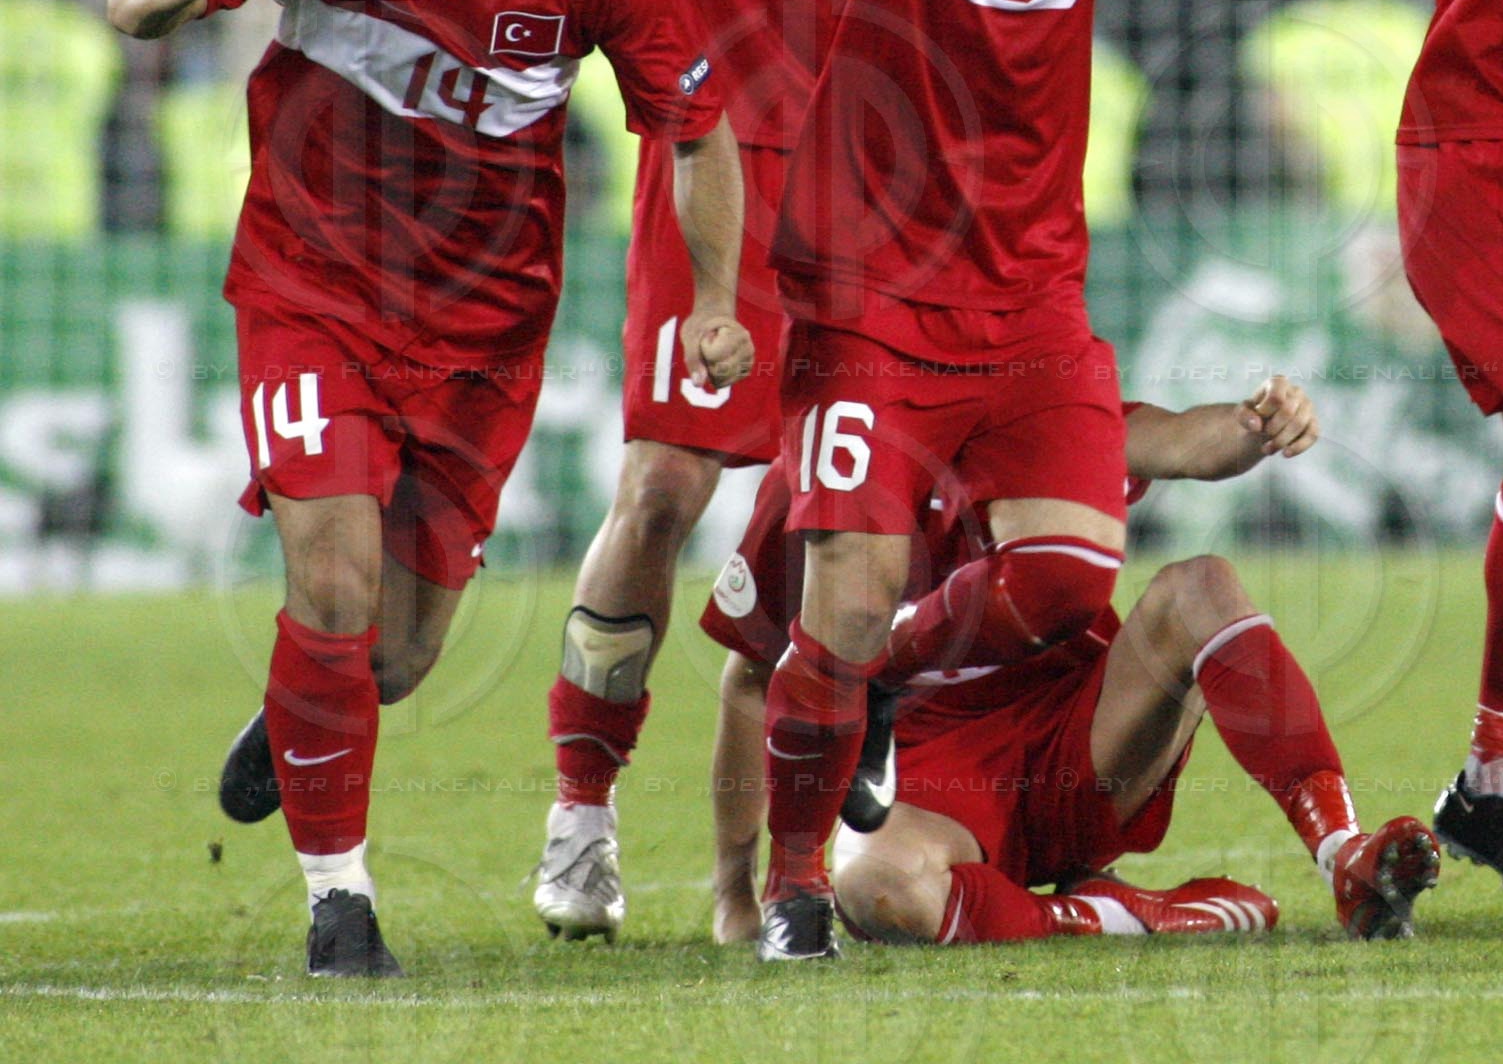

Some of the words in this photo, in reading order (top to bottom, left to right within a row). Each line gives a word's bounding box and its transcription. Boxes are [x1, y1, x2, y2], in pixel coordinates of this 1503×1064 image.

[403, 50, 495, 131] 14
[252, 373, 330, 470] 14
[800, 400, 875, 492] 16
